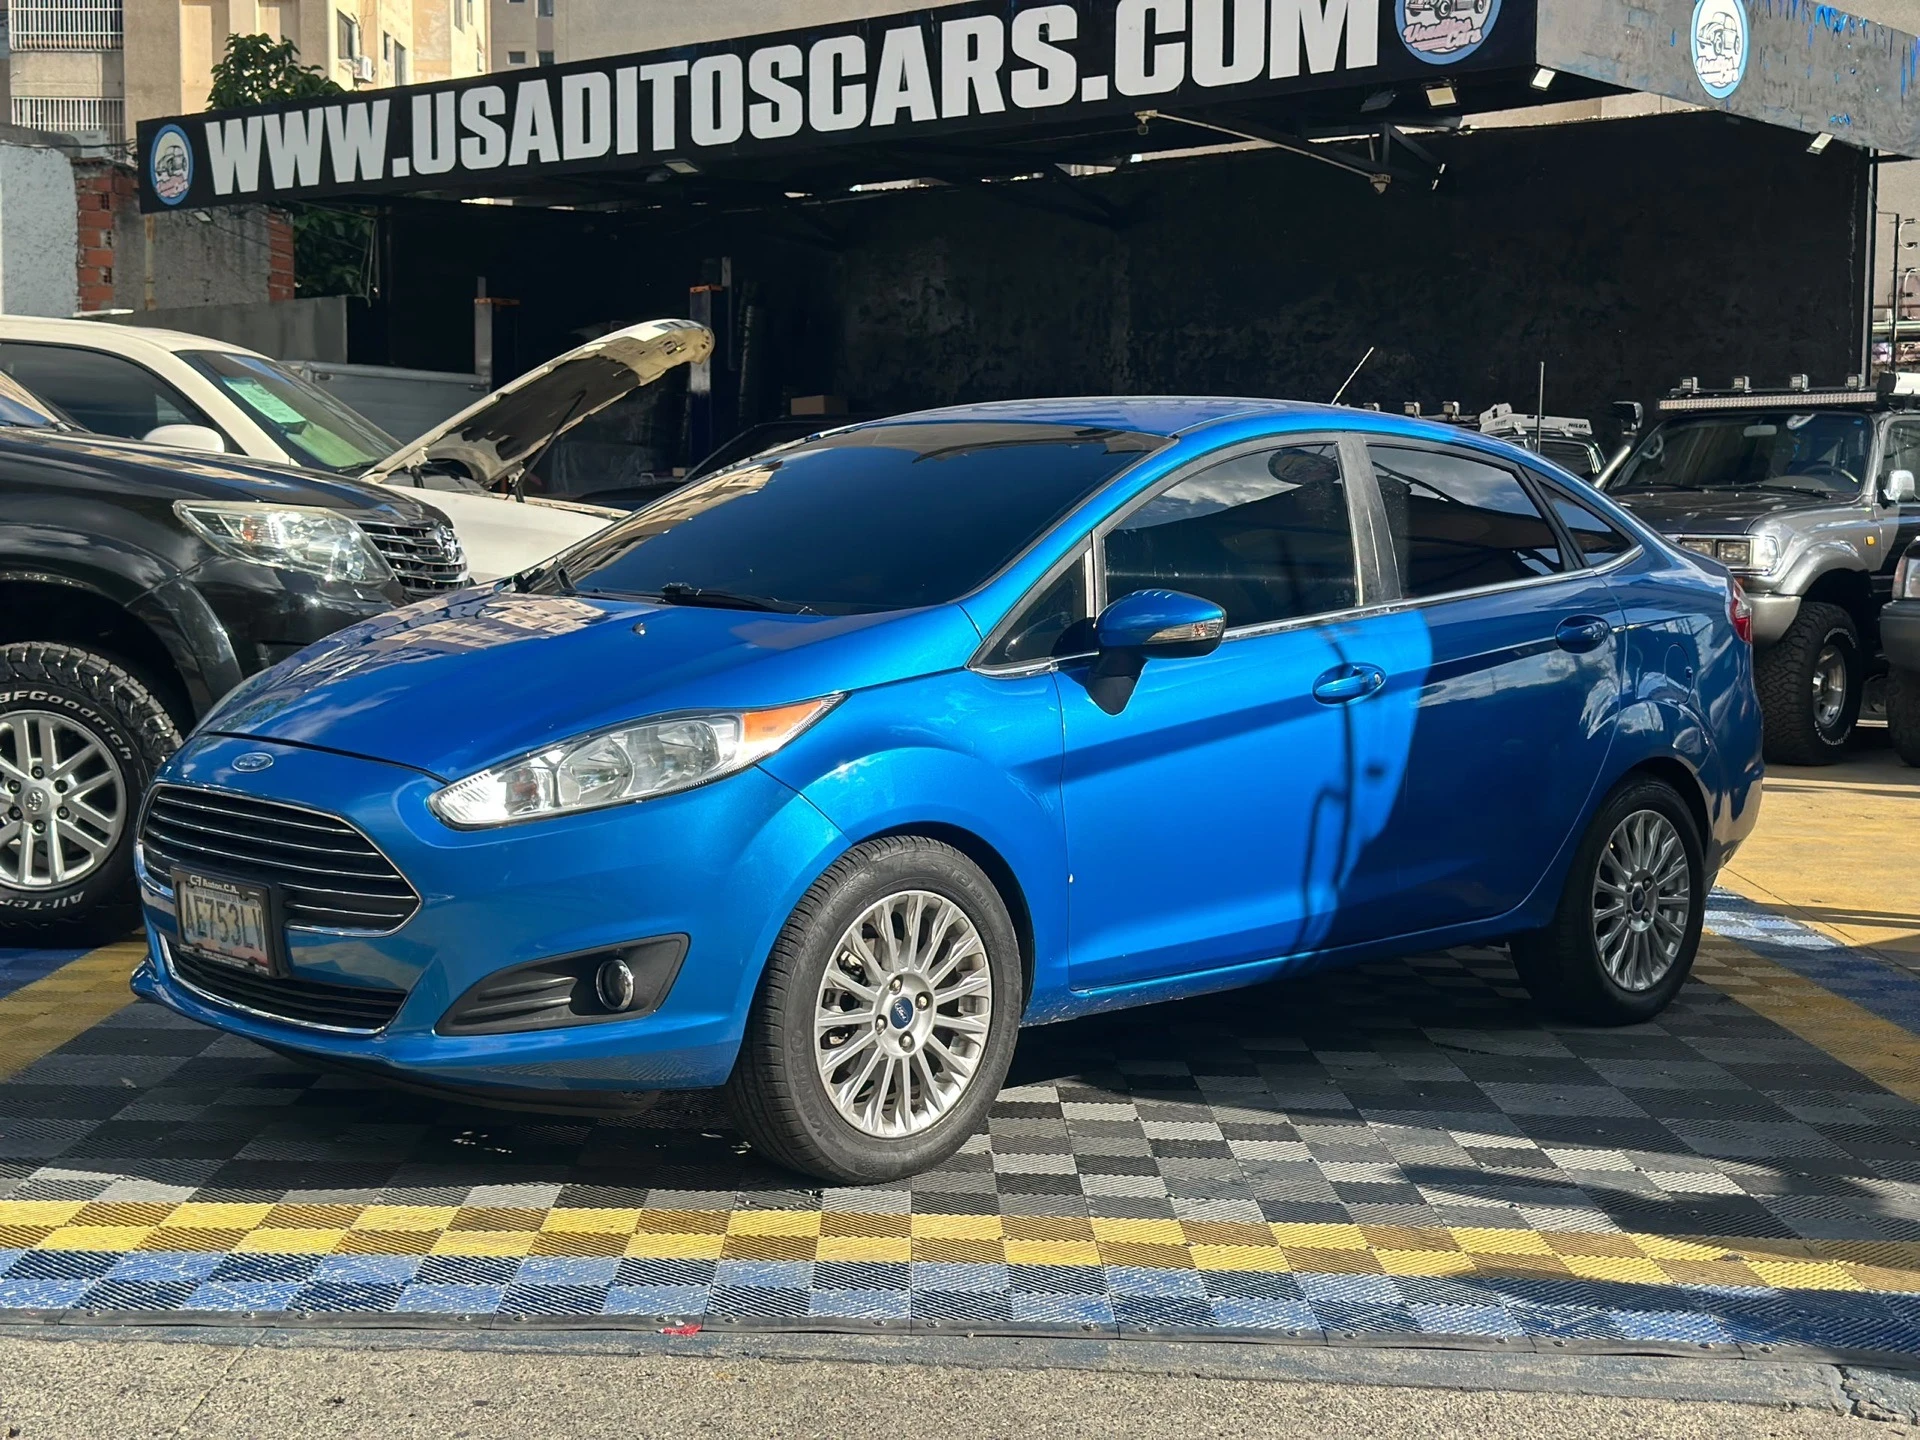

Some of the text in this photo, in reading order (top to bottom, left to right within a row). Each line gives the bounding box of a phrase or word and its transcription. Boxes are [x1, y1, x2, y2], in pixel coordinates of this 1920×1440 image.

[204, 0, 1379, 197] WWW.USADITOSCARS.COM
[0, 690, 132, 760] BFGoodrich
[0, 890, 85, 911] All-Ter
